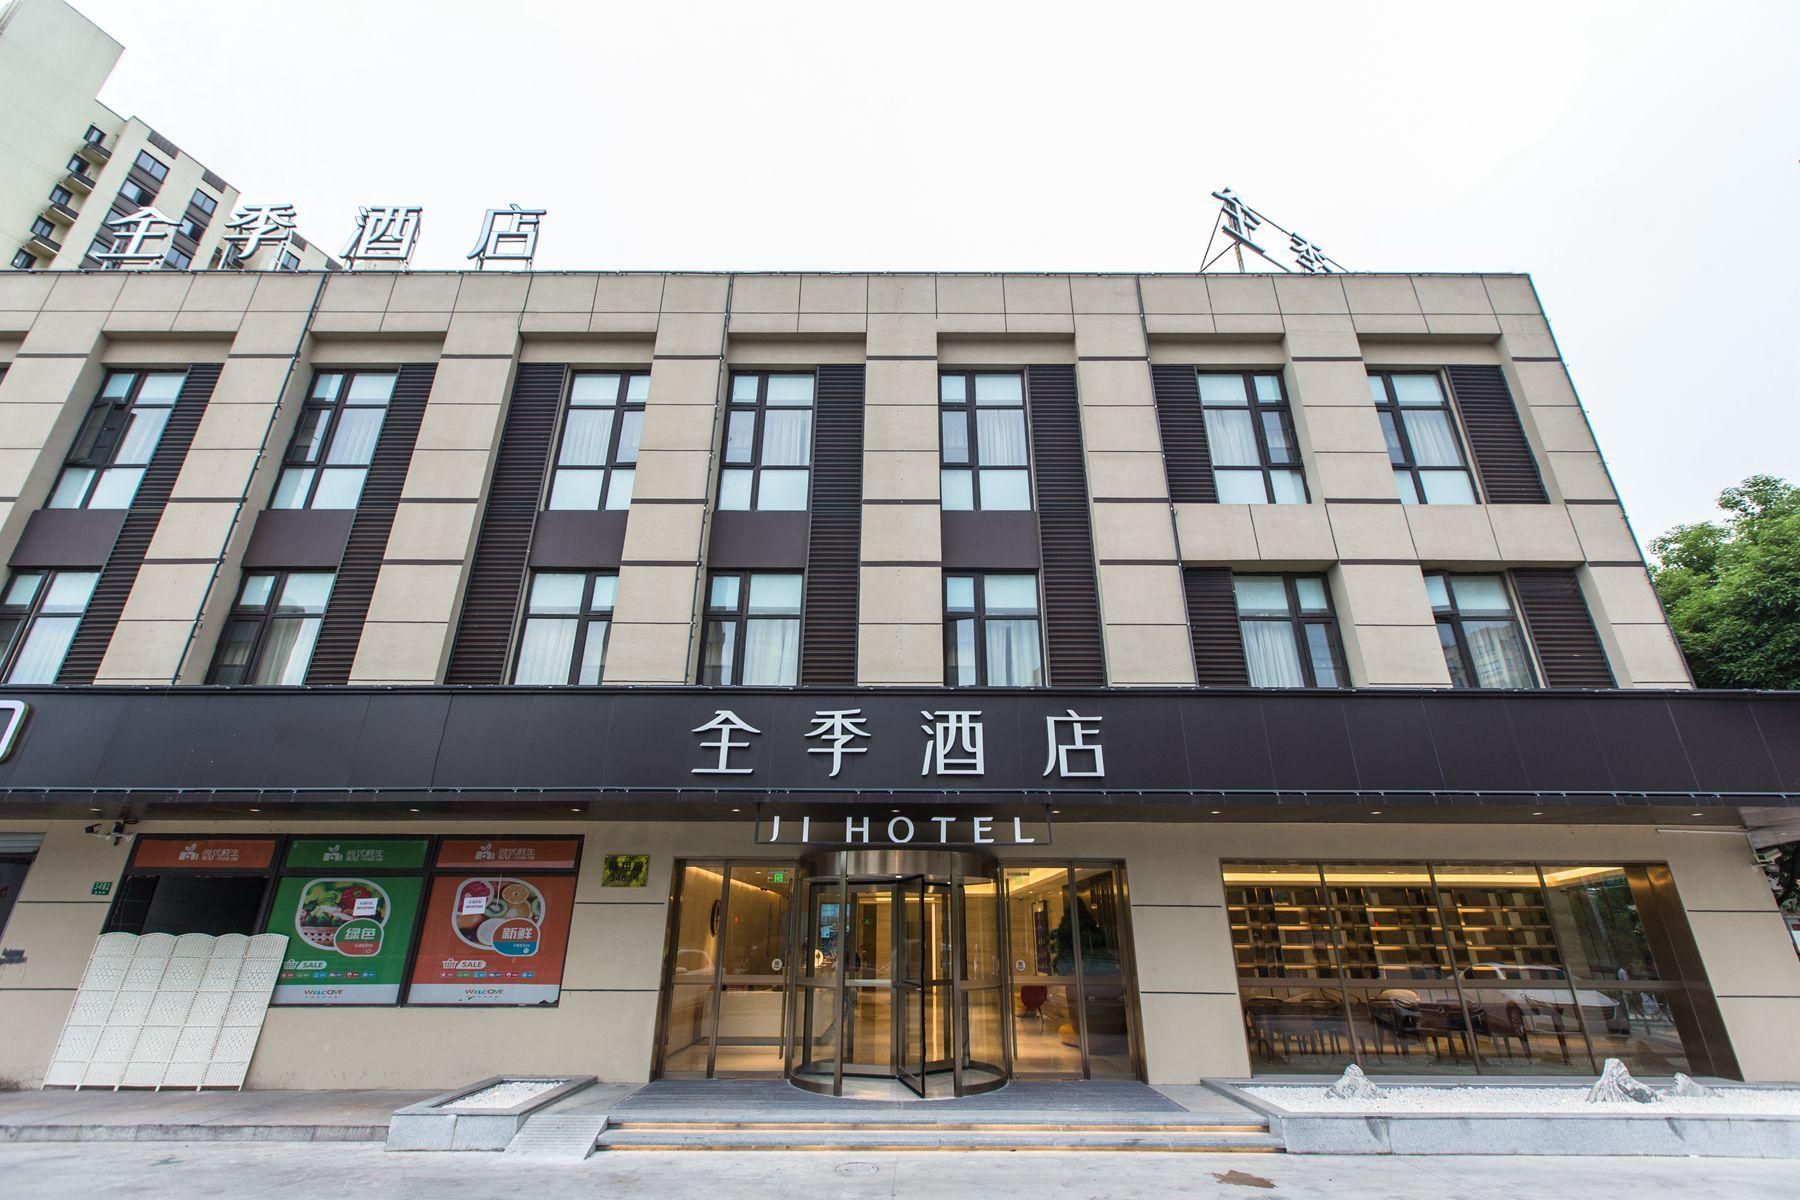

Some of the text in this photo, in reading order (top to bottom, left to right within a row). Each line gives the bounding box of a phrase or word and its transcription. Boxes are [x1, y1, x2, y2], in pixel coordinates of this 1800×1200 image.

[95, 203, 547, 264] 全季酒店
[691, 709, 1106, 778] 全季酒店
[769, 816, 1036, 844] JI HOTEL
[344, 927, 376, 940] 绿色
[501, 927, 533, 940] 新鲜
